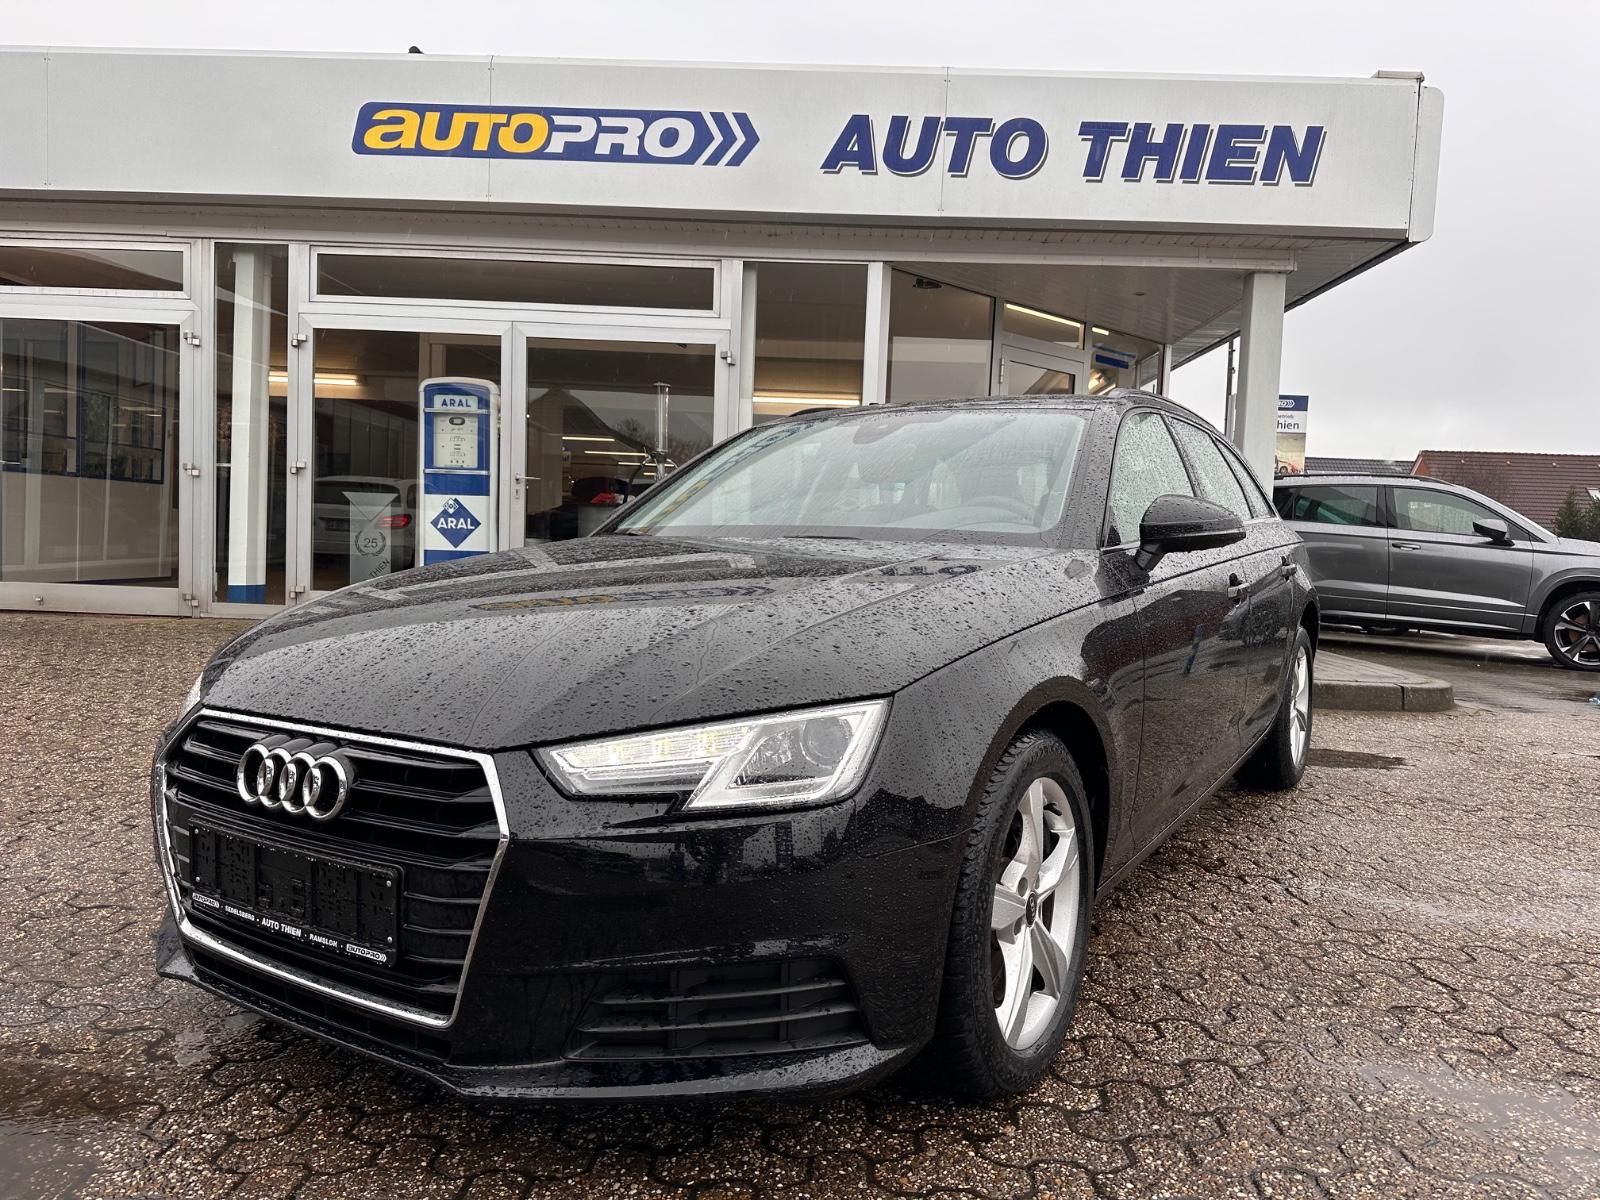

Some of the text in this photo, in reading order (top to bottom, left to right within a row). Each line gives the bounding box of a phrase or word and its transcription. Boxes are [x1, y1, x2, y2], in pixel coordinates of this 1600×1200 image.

[820, 114, 1327, 188] AUTO THIEN
[441, 398, 472, 408] ARAL
[1277, 420, 1299, 430] hien
[437, 517, 475, 530] ARAL
[363, 538, 378, 549] 25
[369, 558, 391, 578] THIEN
[261, 917, 280, 931] AUTO
[280, 923, 302, 938] THIEN
